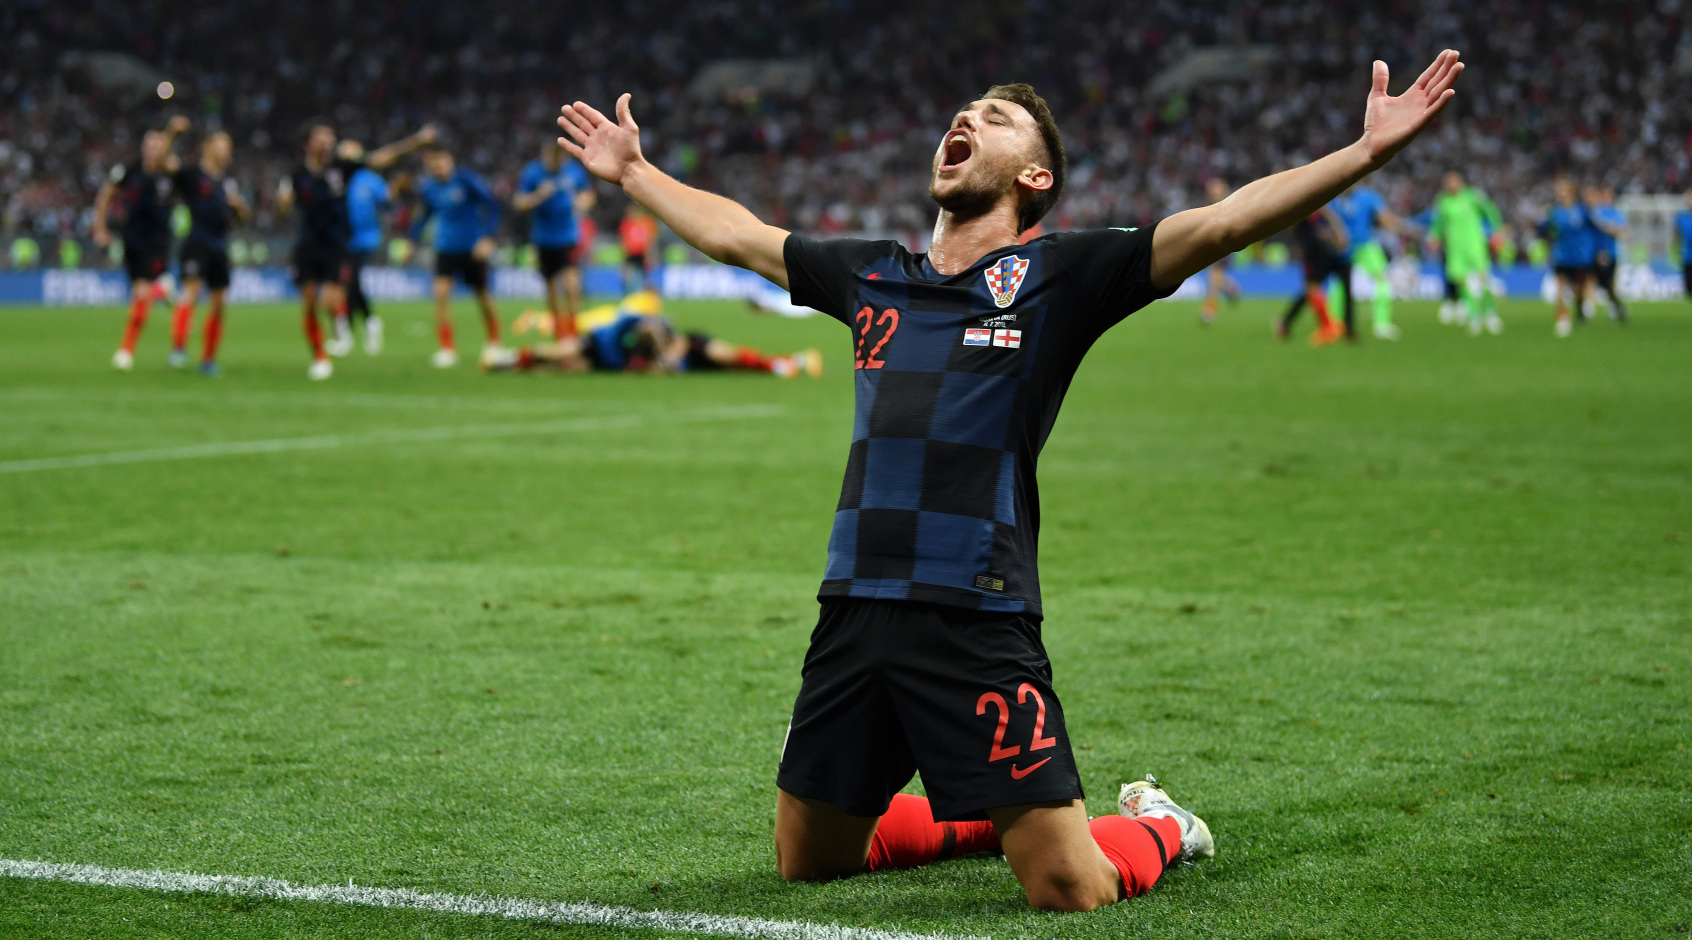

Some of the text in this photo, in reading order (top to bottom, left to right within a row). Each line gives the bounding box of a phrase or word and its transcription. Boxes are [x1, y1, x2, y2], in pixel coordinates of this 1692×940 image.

[1003, 262, 1011, 288] HNS
[855, 306, 900, 370] 22
[976, 682, 1056, 762] 22
